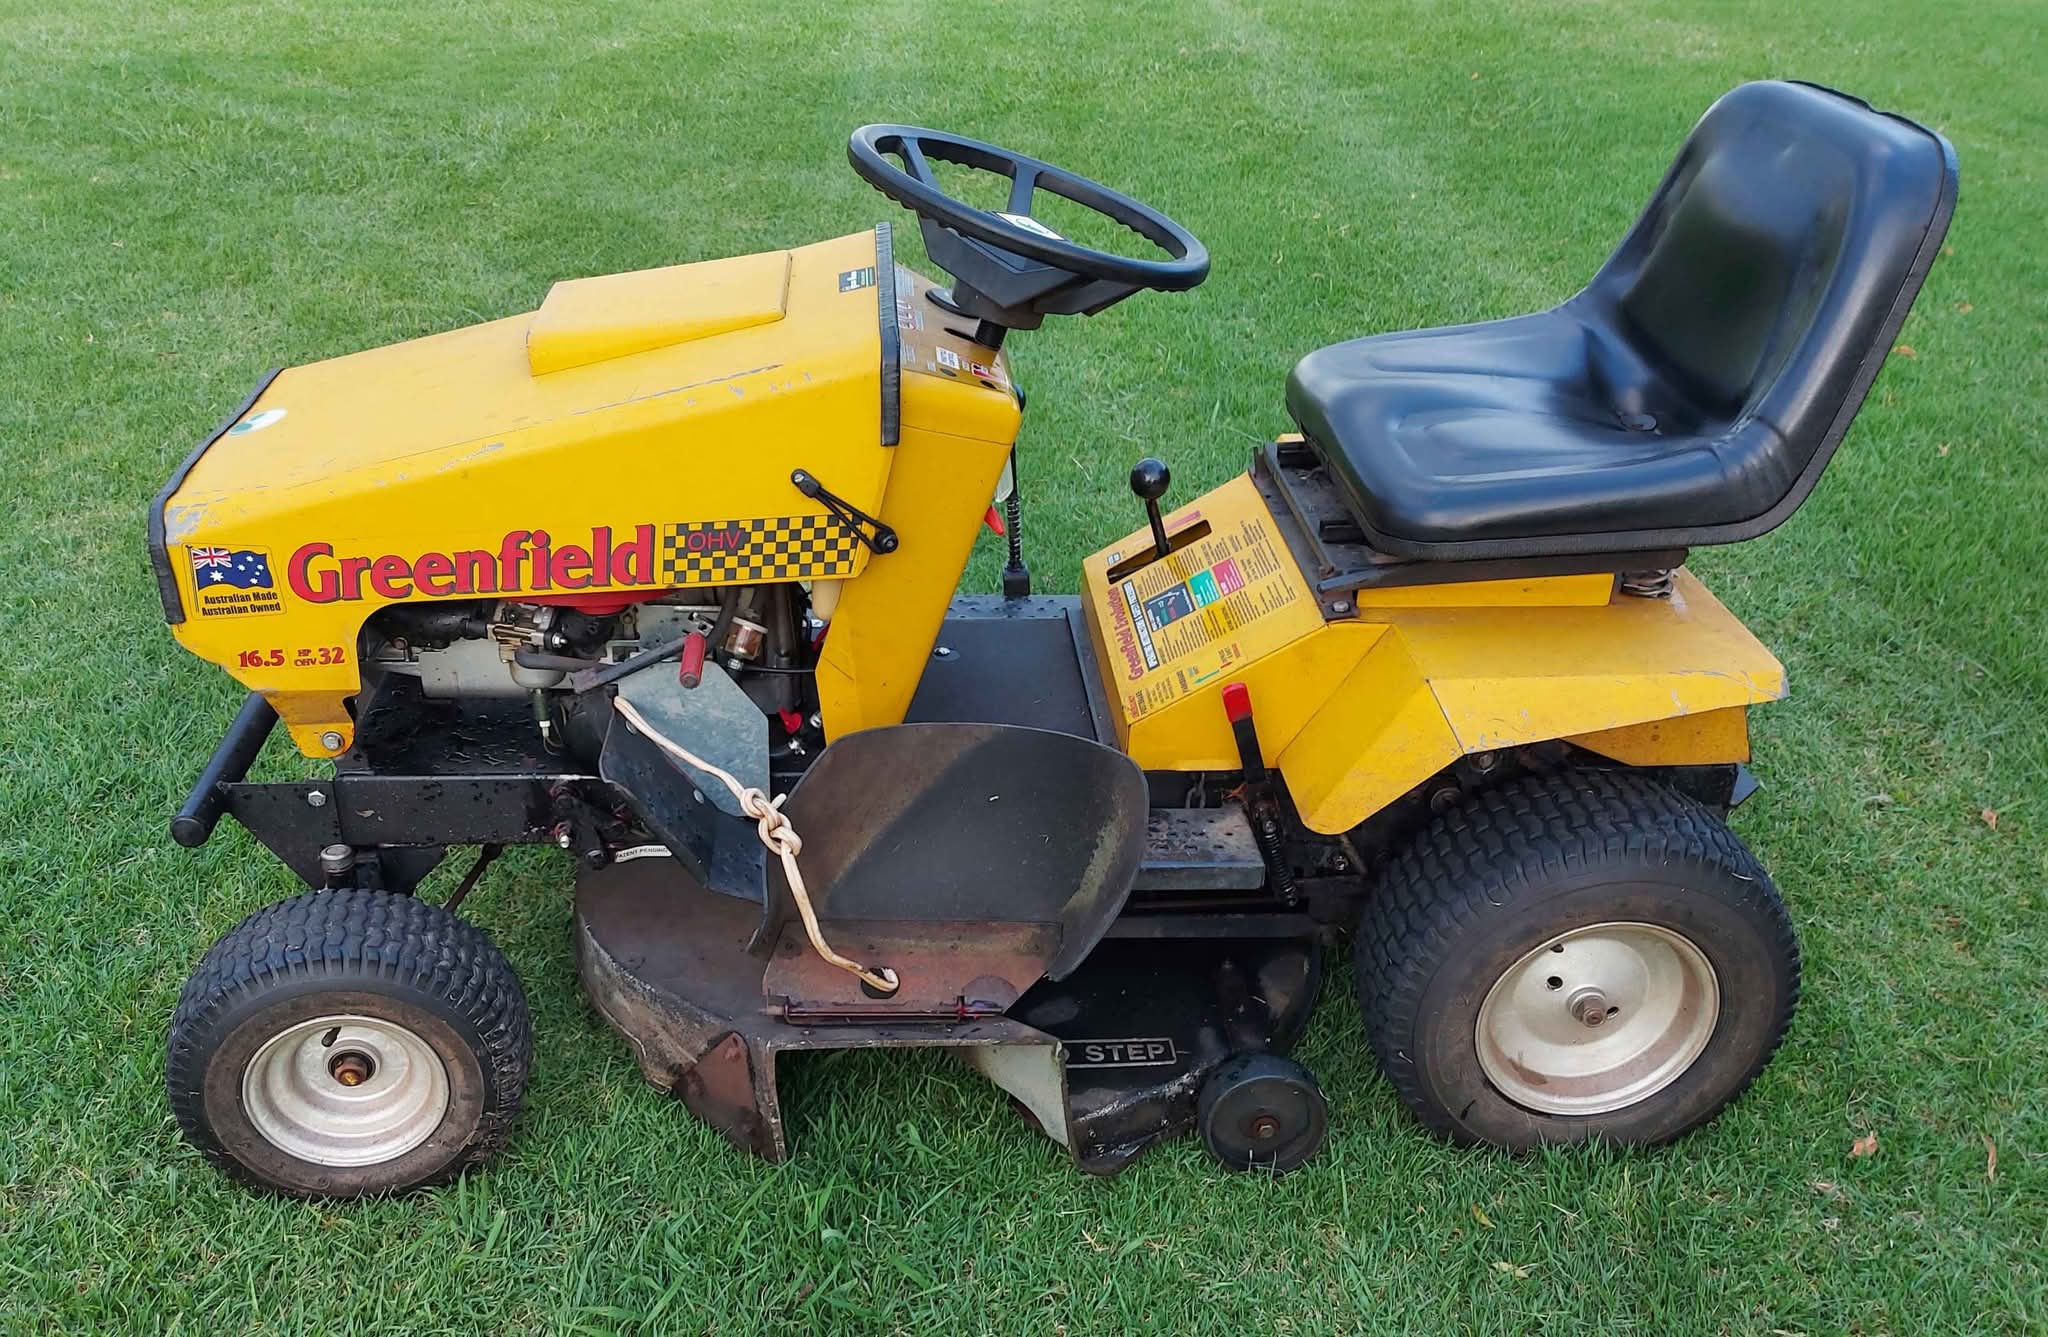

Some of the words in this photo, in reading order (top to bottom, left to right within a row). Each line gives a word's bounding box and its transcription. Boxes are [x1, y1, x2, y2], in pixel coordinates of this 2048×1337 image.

[687, 530, 742, 552] OHV
[288, 524, 655, 603] Greenfield
[204, 594, 251, 604] Australian
[253, 592, 279, 601] Made
[202, 605, 249, 615] Australian
[250, 602, 281, 612] Owned
[238, 649, 285, 667] 16.5
[318, 647, 345, 665] 32
[1085, 1044, 1165, 1062] STEP
